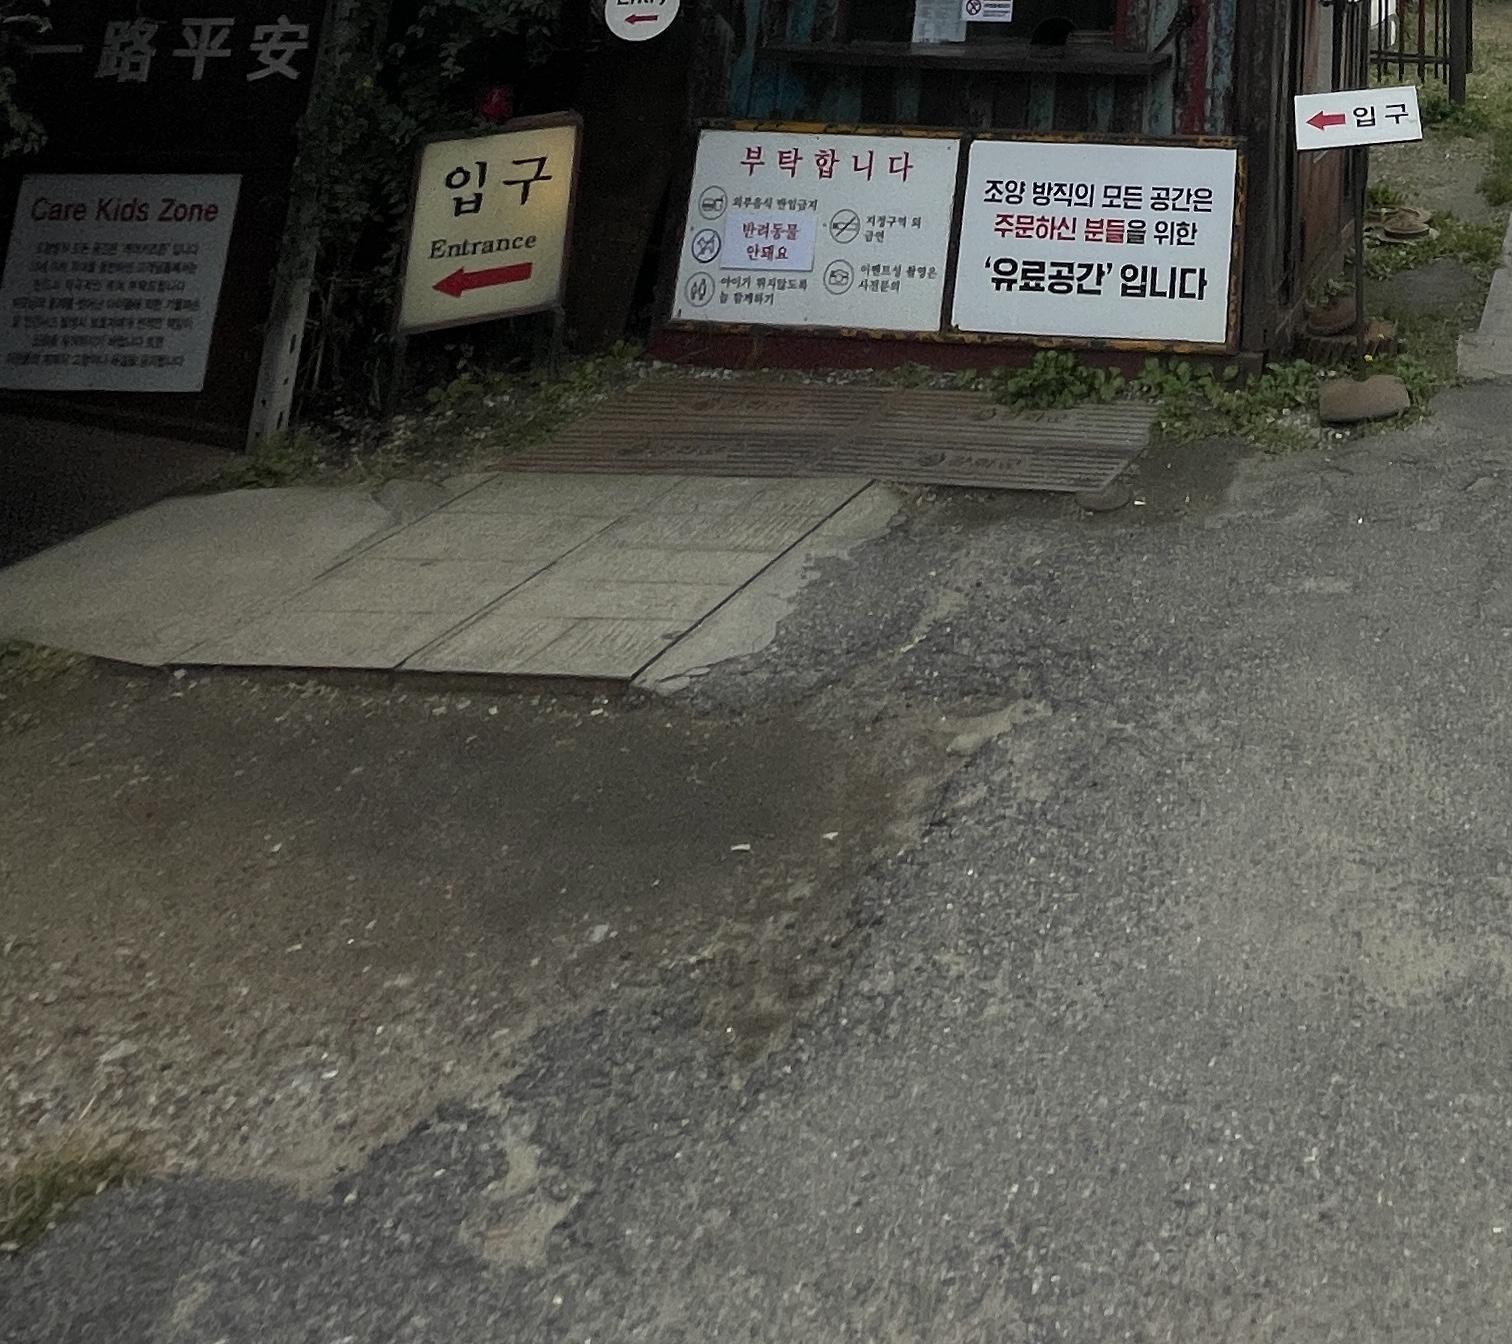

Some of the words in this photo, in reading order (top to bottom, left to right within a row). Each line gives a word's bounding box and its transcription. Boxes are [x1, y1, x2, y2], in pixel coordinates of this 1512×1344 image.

[24, 14, 311, 83] 一路平安
[1352, 103, 1409, 128] 입구
[740, 146, 914, 182] 부탁합니다
[445, 156, 553, 217] 입구
[983, 179, 1026, 205] 조양
[1032, 181, 1095, 208] 방직의
[1101, 184, 1143, 210] 모든
[1150, 186, 1213, 213] 공간은
[31, 197, 87, 221] Care
[95, 198, 149, 221] Kids
[157, 198, 219, 222] Zone
[776, 197, 818, 211] 반입금지
[742, 221, 801, 241] 반려동물
[993, 213, 1077, 241] 주문하신
[1084, 217, 1147, 245] 분들을
[1153, 220, 1198, 246] 위한
[428, 234, 537, 259] Entrance
[1119, 263, 1208, 301] 입니다
